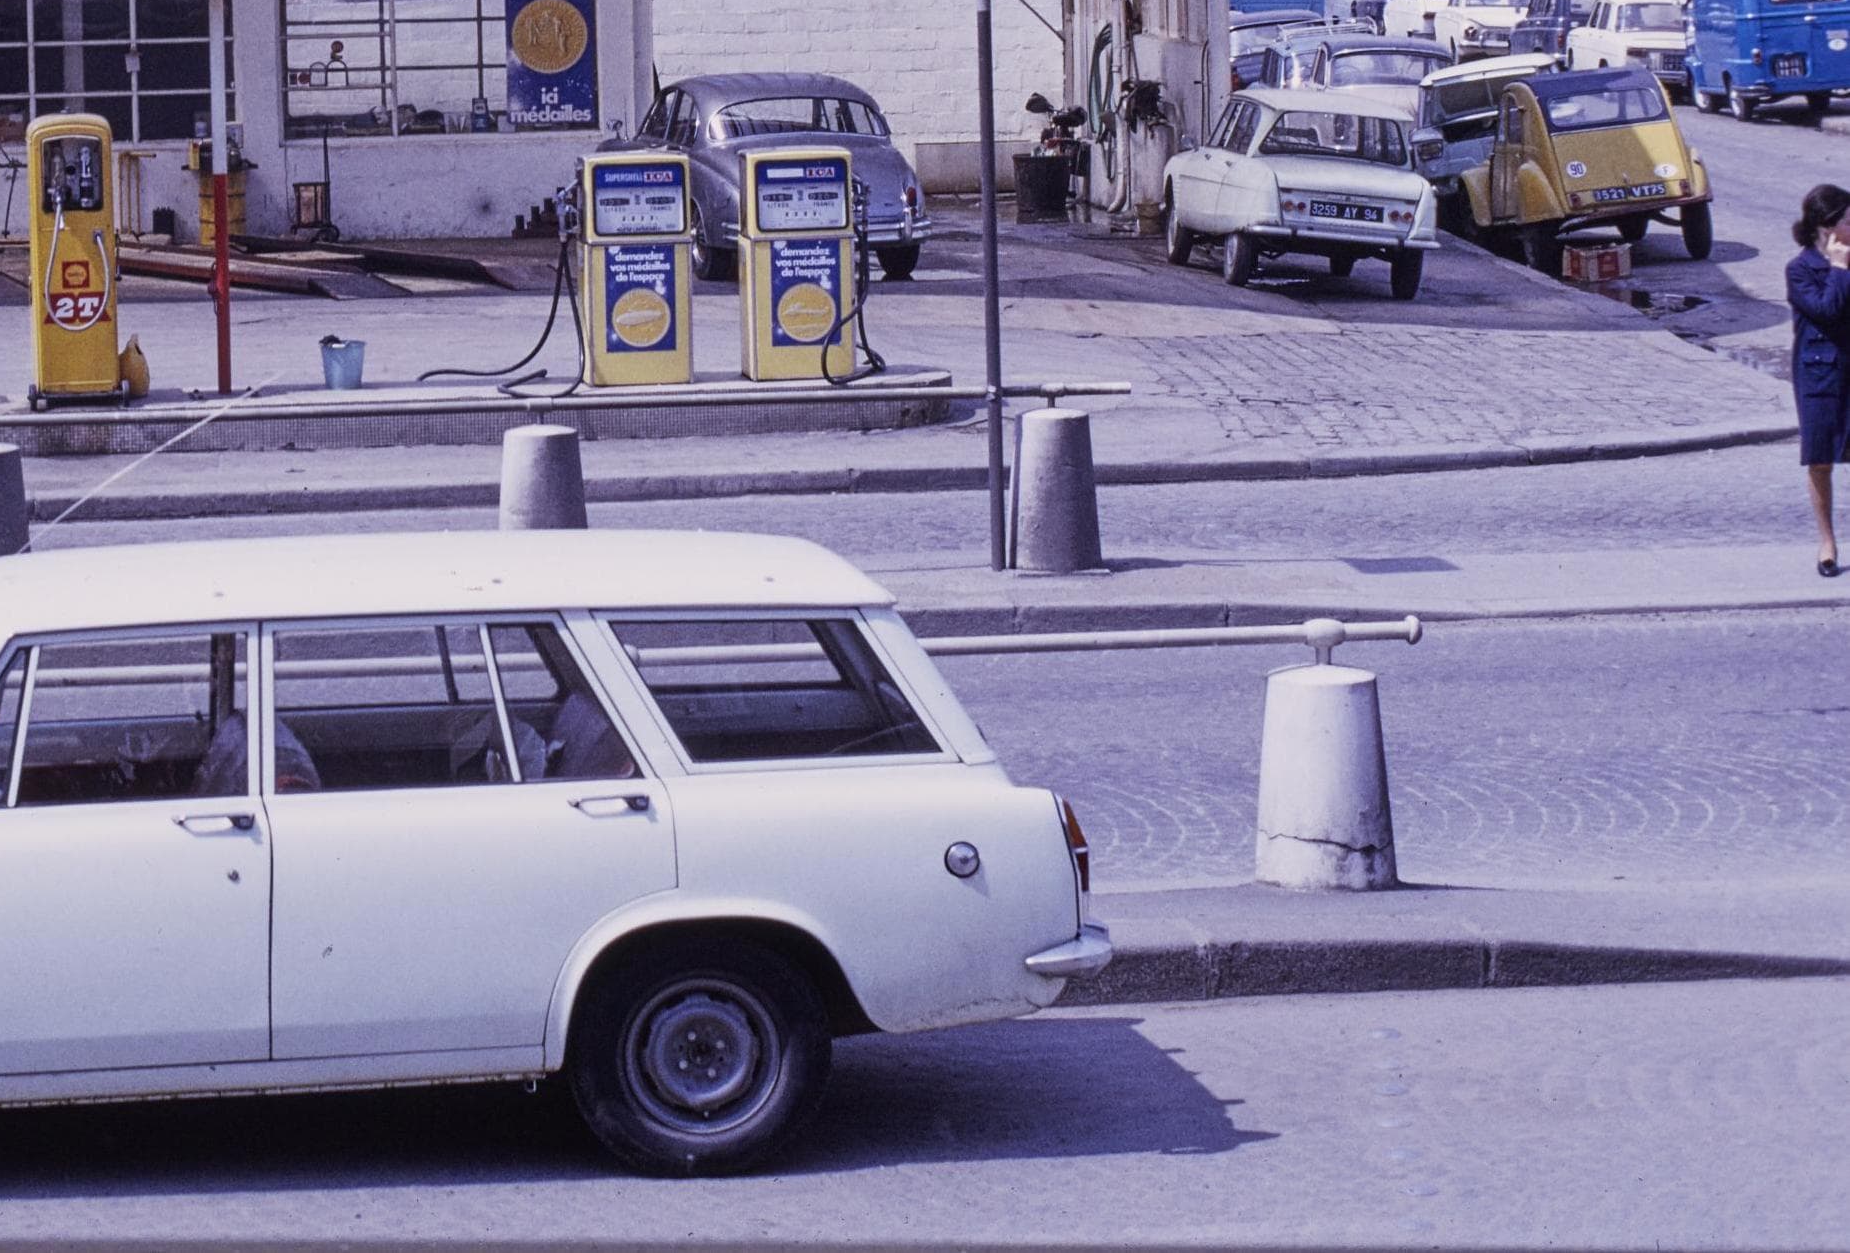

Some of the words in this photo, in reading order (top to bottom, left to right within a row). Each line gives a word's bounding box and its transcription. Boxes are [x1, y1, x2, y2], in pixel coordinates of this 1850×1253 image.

[541, 87, 558, 104] ici
[510, 104, 592, 123] médailles
[1570, 163, 1583, 175] 90
[1343, 207, 1358, 218] AY
[615, 250, 664, 262] demandez
[780, 246, 830, 256] demandez
[628, 261, 670, 271] médailles
[775, 259, 792, 267] vos
[793, 256, 836, 266] médailles
[615, 272, 628, 282] de
[781, 267, 794, 277] de
[55, 297, 99, 318] 2T
